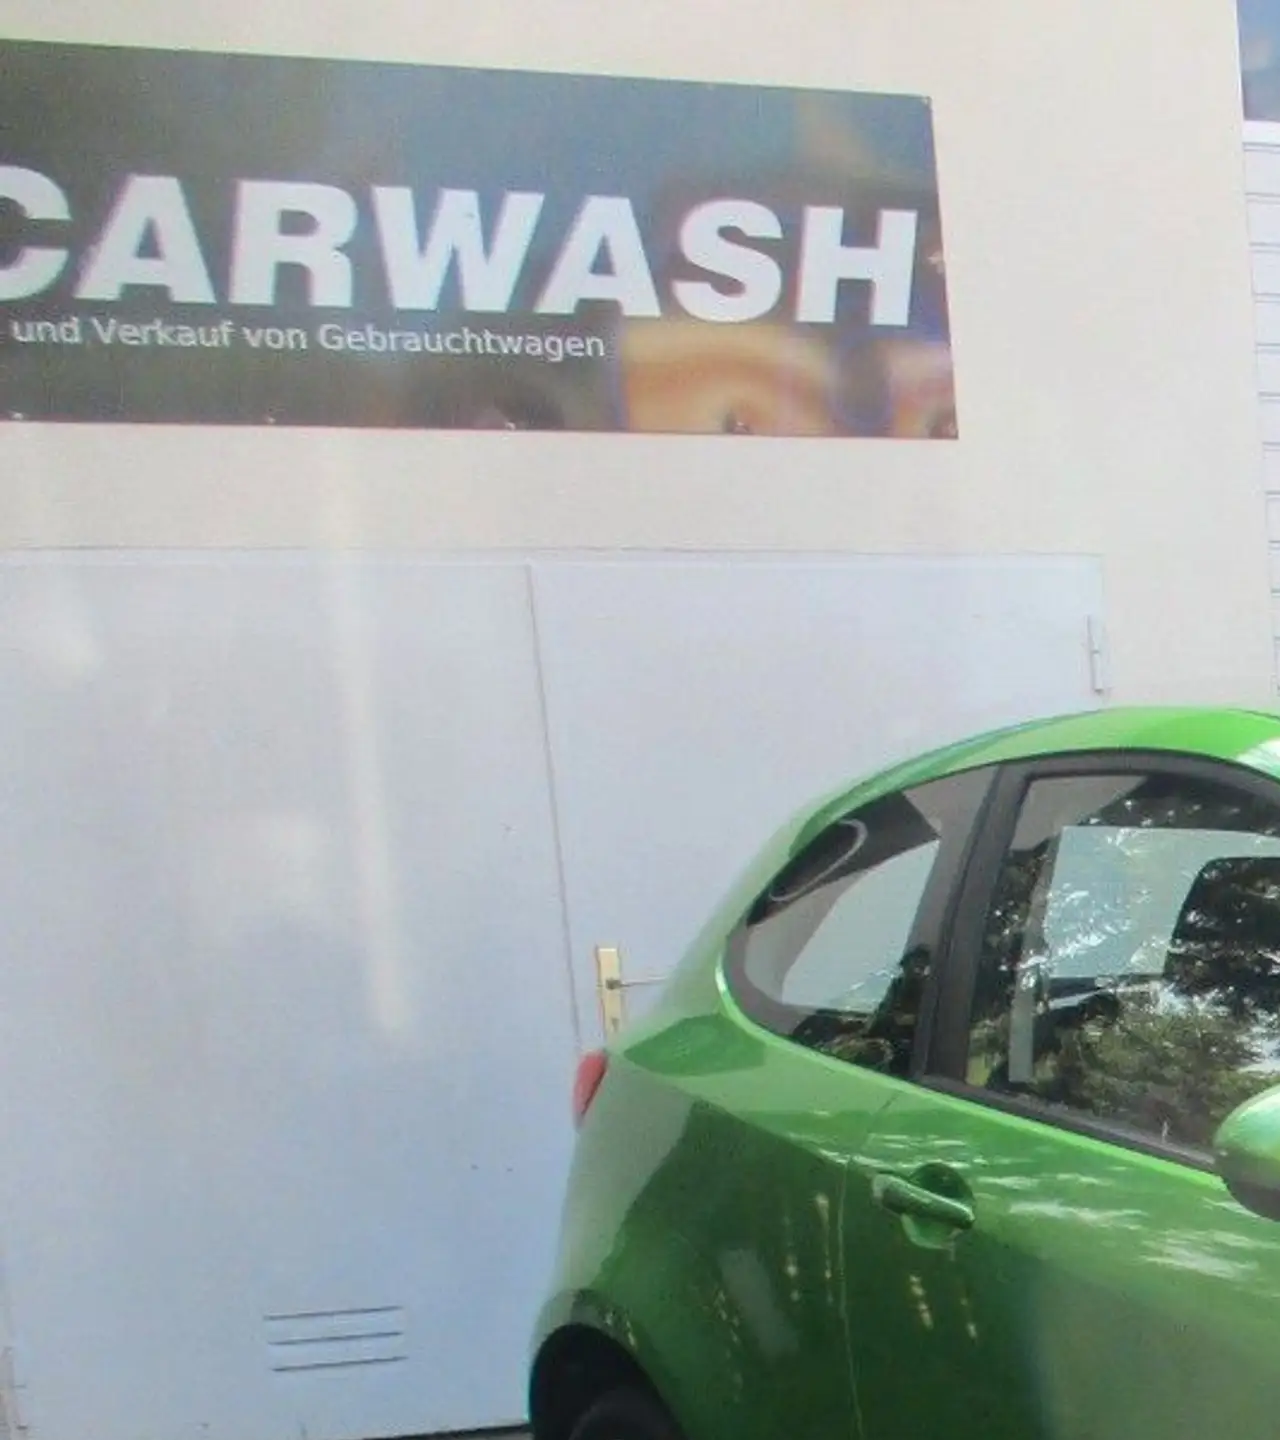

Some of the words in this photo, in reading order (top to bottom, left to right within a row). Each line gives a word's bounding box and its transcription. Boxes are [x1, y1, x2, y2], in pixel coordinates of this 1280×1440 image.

[0, 165, 917, 327] CARWASH
[11, 317, 82, 343] und
[91, 318, 235, 347] Verkauf
[243, 325, 308, 350] von
[318, 323, 605, 362] Gebrauchtwagen
